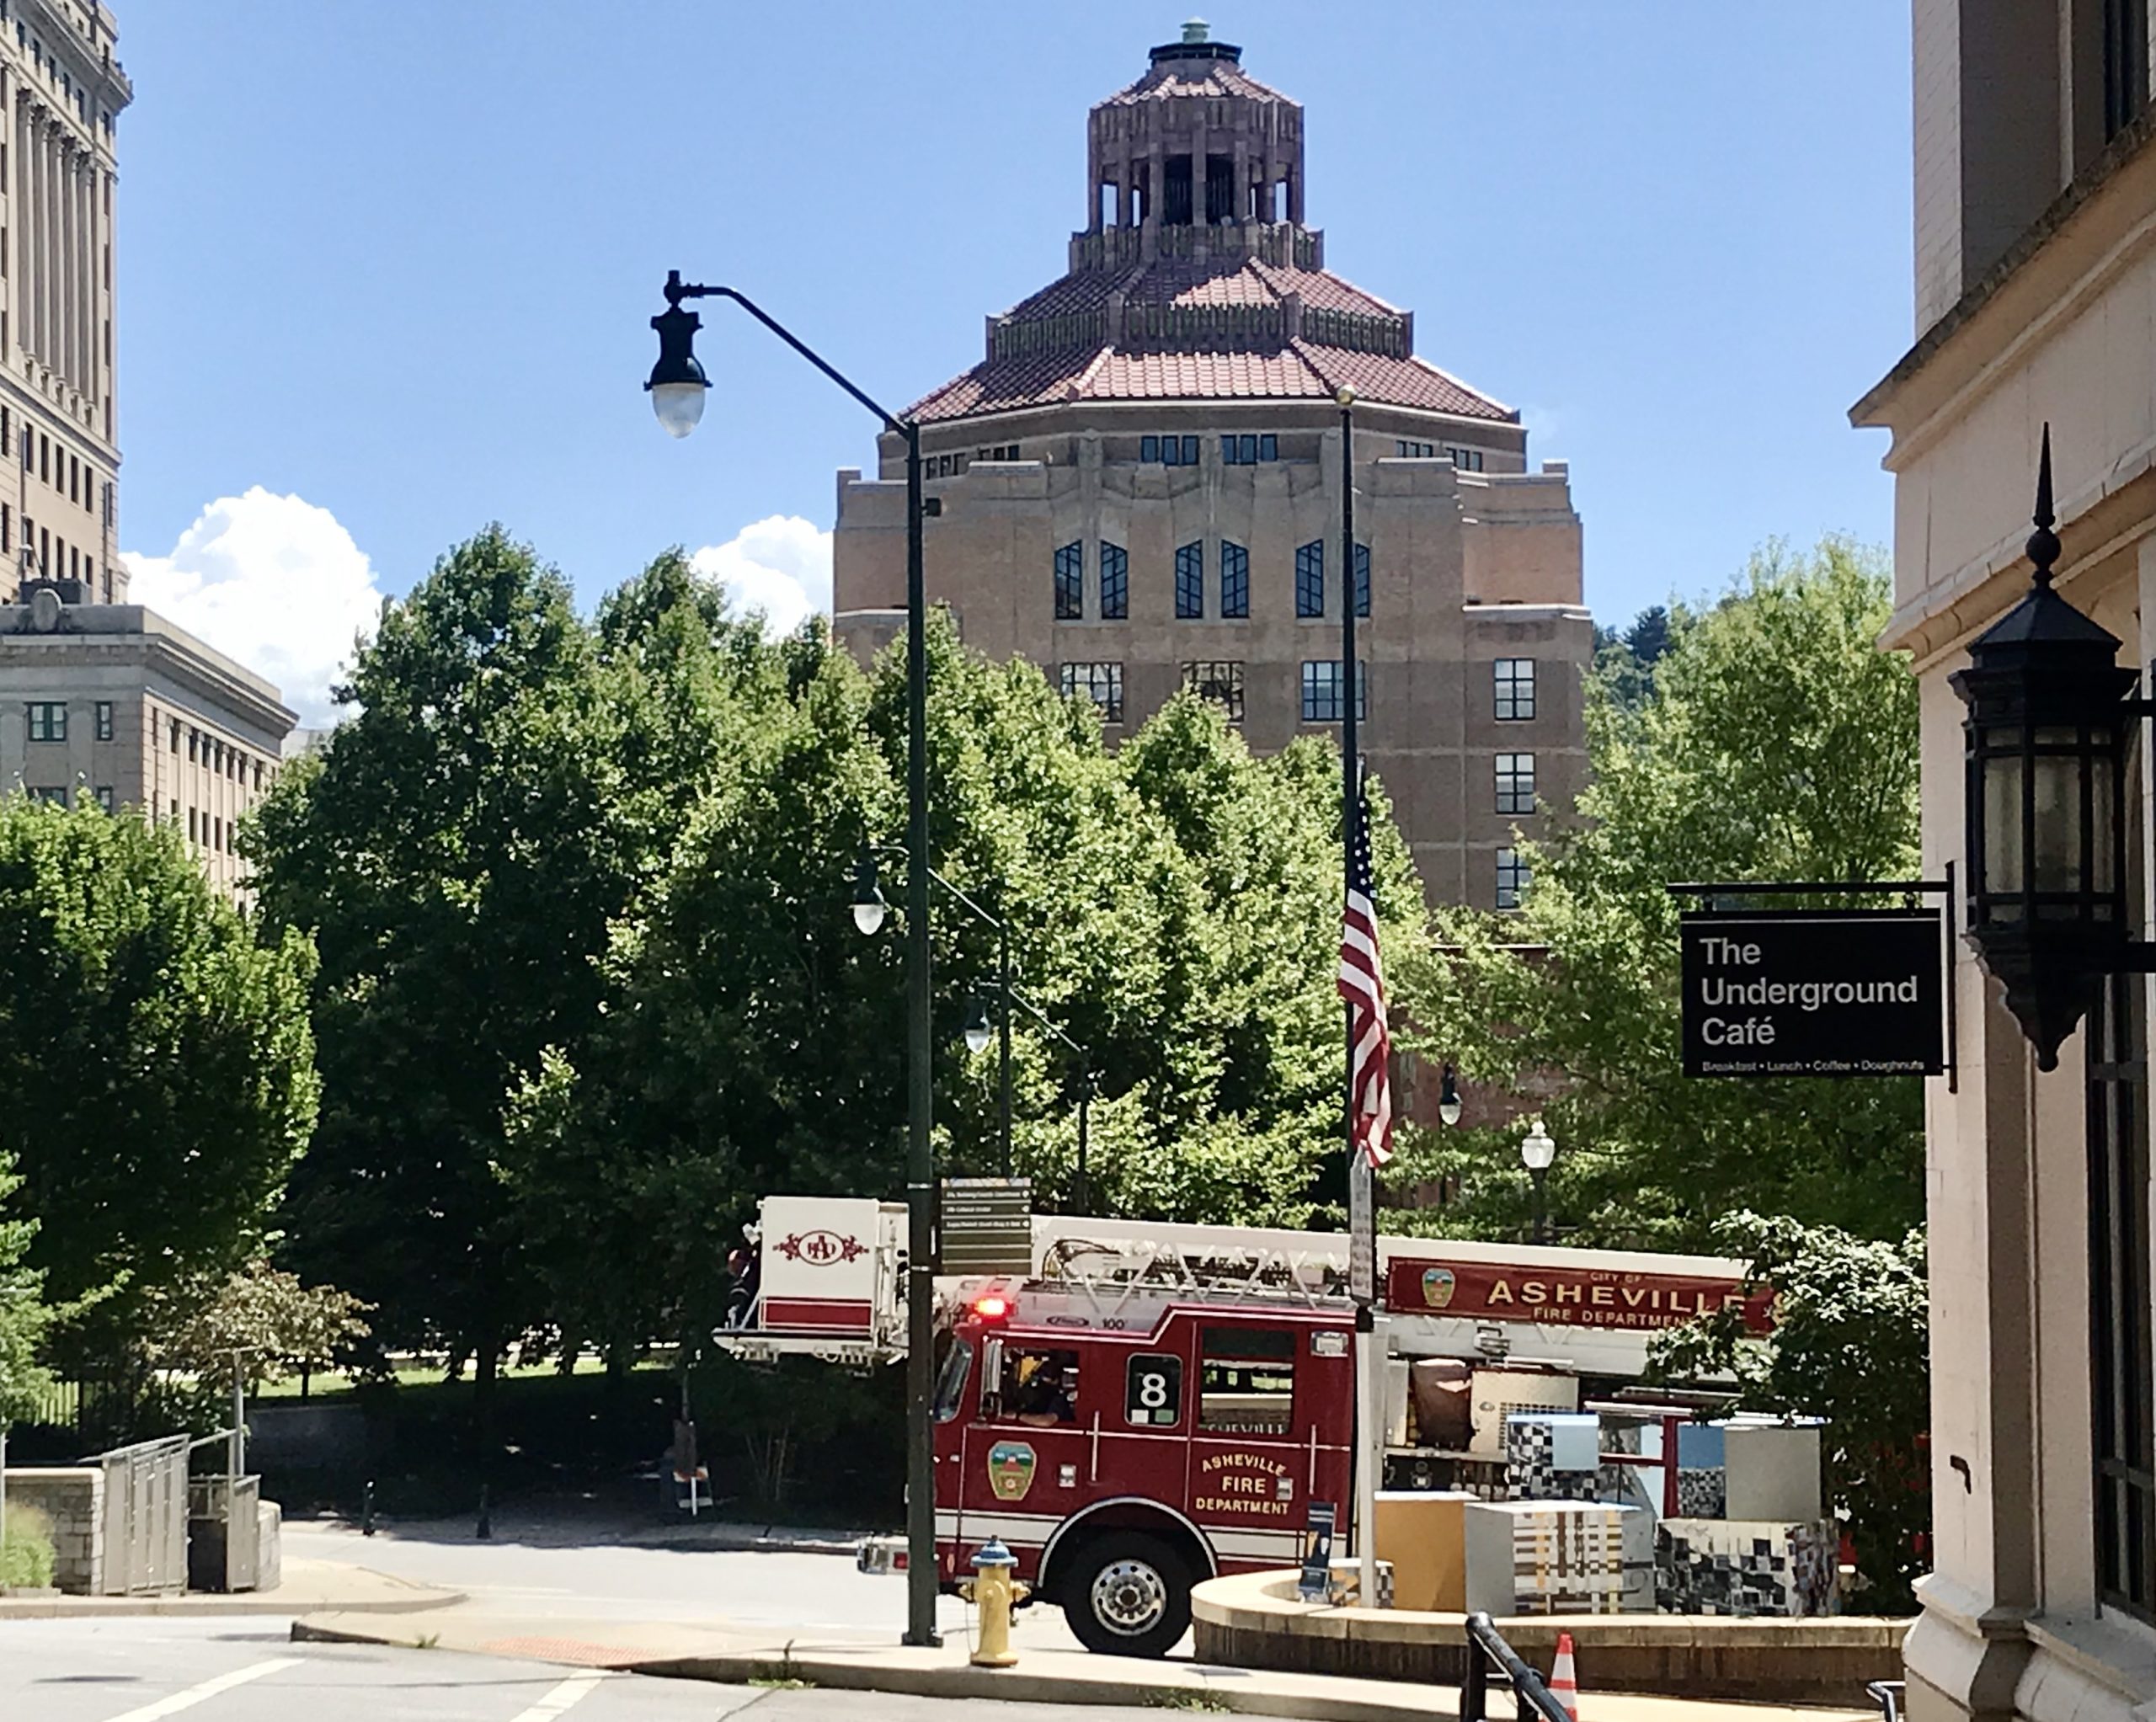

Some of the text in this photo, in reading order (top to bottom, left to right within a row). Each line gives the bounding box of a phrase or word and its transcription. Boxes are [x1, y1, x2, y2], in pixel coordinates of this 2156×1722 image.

[1699, 937, 1761, 965] The
[1701, 975, 1918, 1011] Underground
[1701, 1016, 1775, 1046] Café
[1767, 1061, 1803, 1072] Lunch
[1813, 1060, 1852, 1072] Coffee
[1861, 1059, 1925, 1073] Doughnuts
[1589, 1272, 1642, 1283] CITY OF
[1487, 1279, 1746, 1321] ASHEVILLE
[1534, 1306, 1689, 1328] FIRE DEPARTMEN
[1140, 1373, 1166, 1407] 8
[1202, 1453, 1287, 1477] ASHEVILLE
[1222, 1475, 1267, 1494] FIRE
[1195, 1497, 1289, 1515] DEPARTMENT
